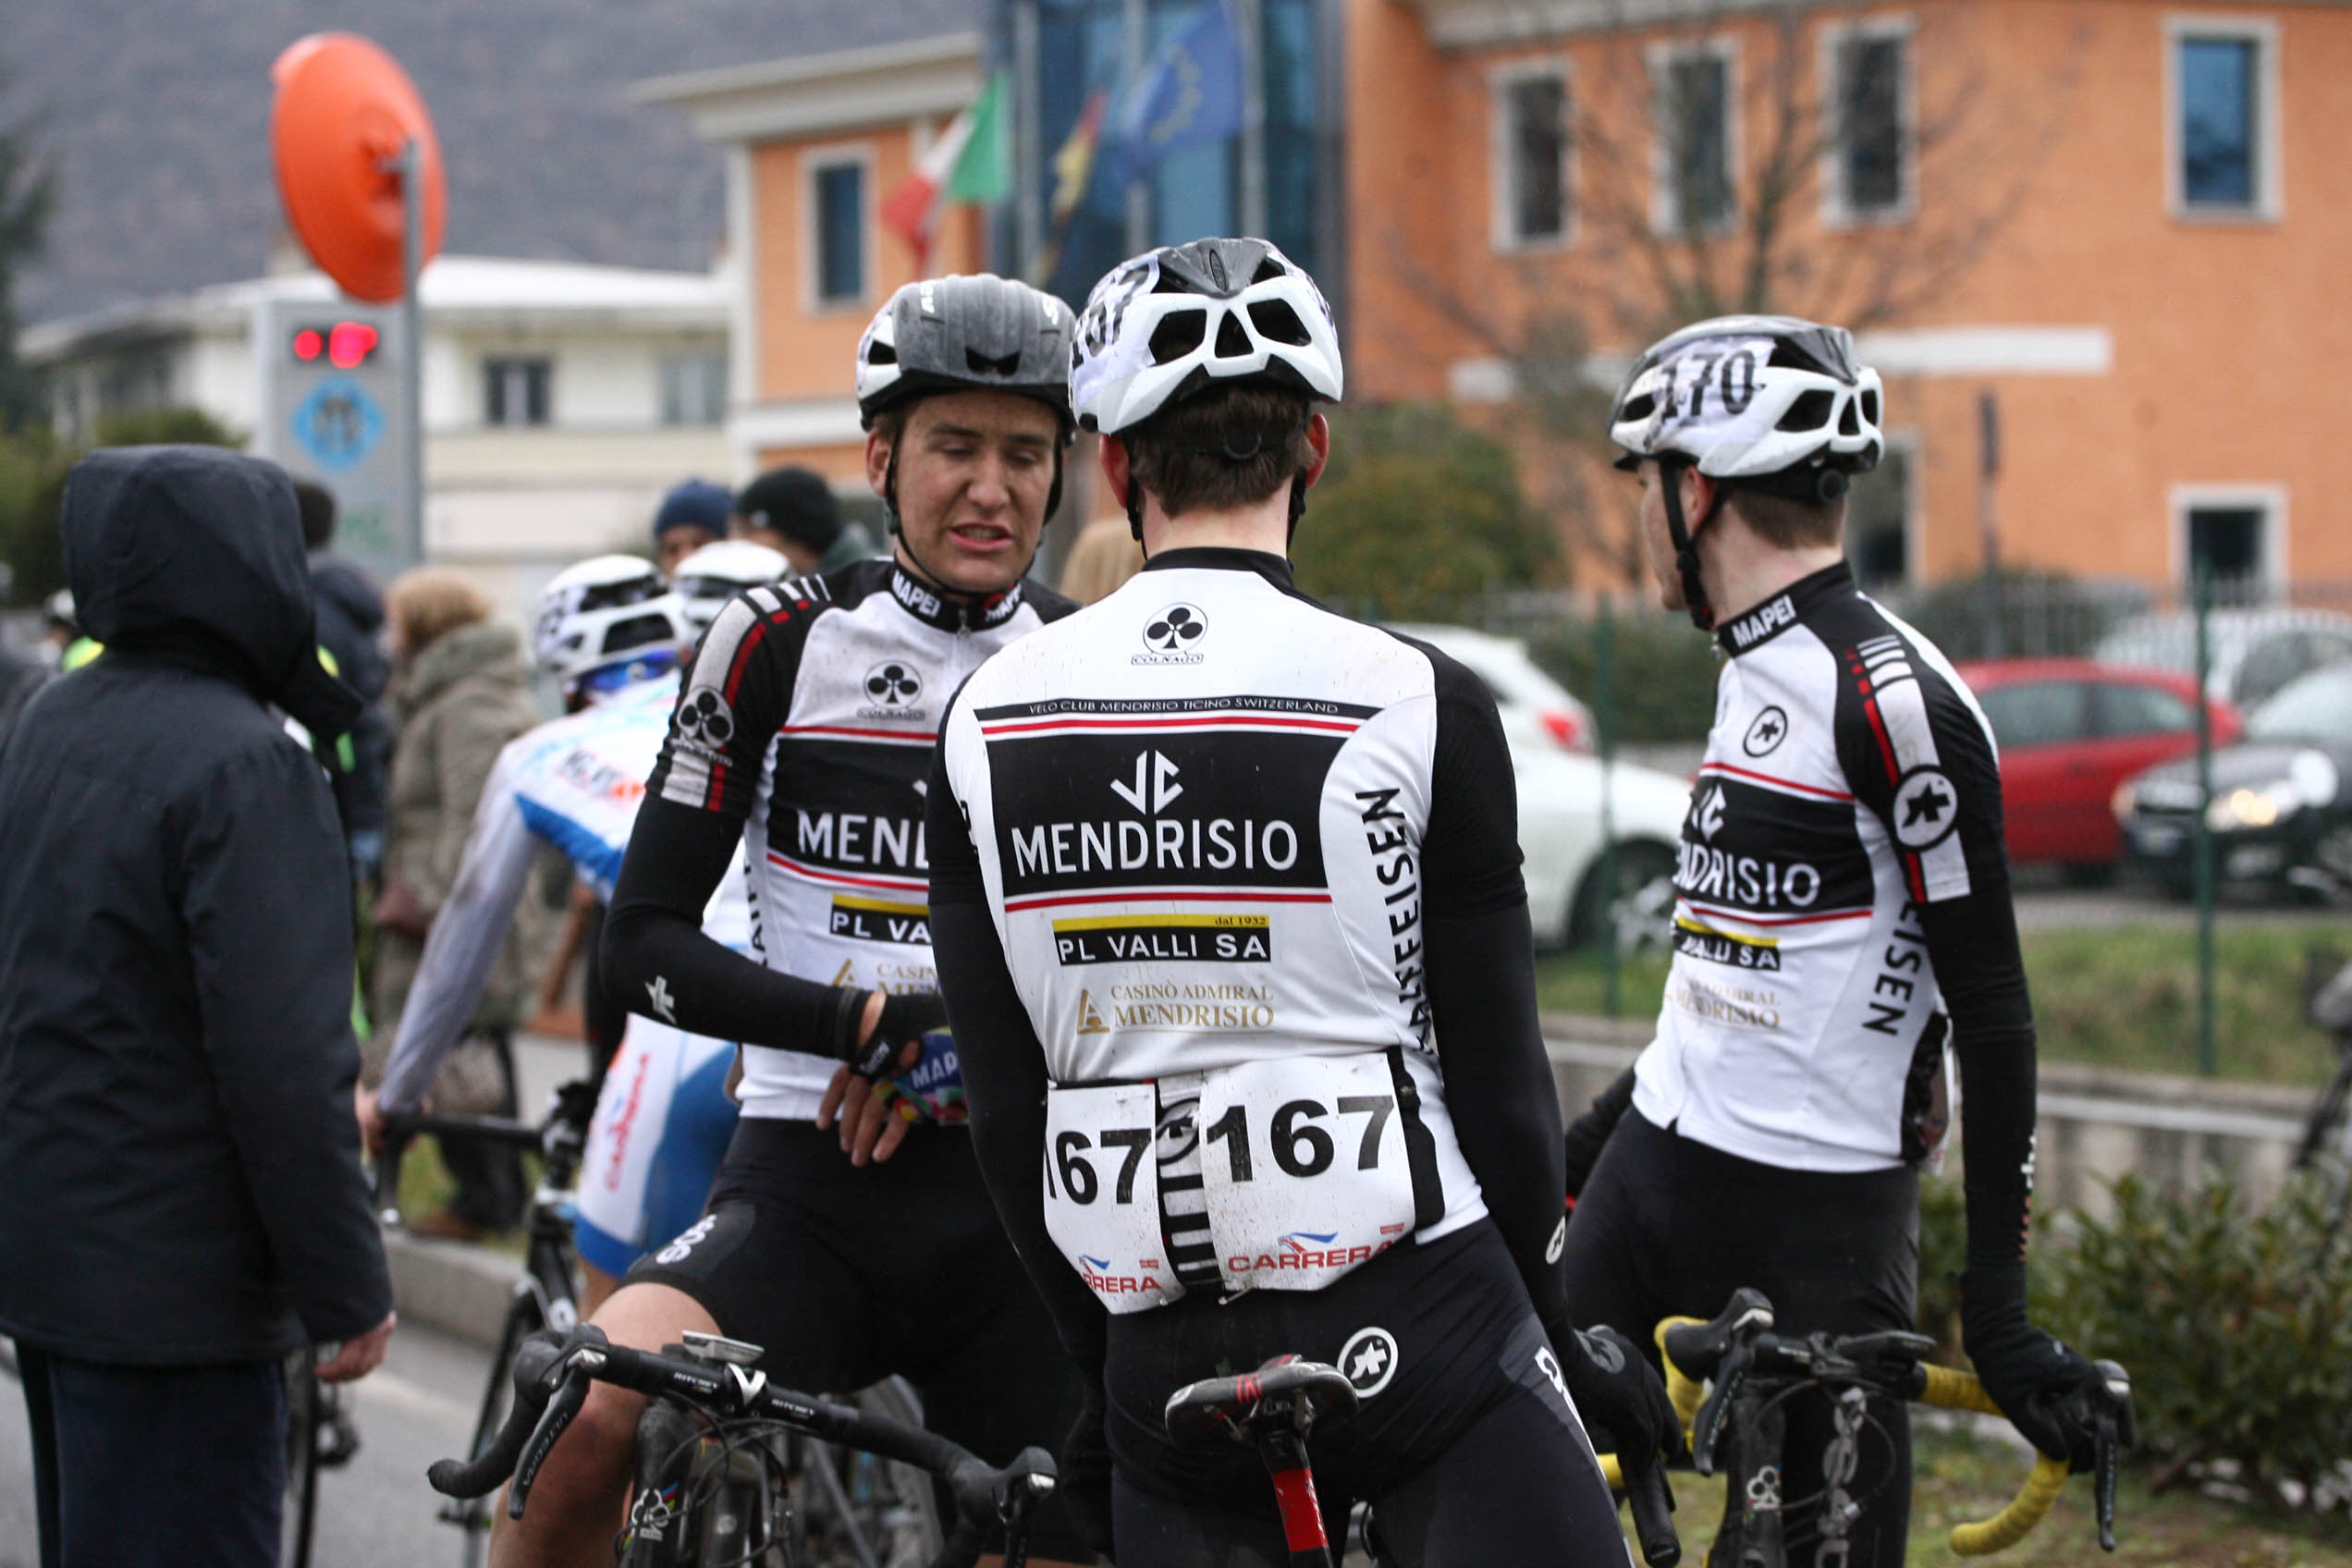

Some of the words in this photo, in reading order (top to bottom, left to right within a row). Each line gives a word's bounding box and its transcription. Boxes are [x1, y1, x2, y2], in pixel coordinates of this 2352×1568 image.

[1660, 349, 1756, 424] 170
[892, 570, 941, 618] MAPEI
[1731, 594, 1797, 648] MAPEI
[1029, 701, 1058, 715] VELO
[1060, 699, 1096, 712] CLUB
[1100, 701, 1179, 713] MENDRISIO
[1183, 699, 1231, 710] TICINO
[1235, 697, 1339, 714] SWITZERLAND
[1011, 818, 1298, 877] MENDRISIO
[833, 912, 872, 937] PL
[1215, 915, 1233, 925] dal
[1059, 938, 1096, 962] PL
[1108, 934, 1197, 958] VALLI
[1216, 934, 1267, 958] SA
[1739, 945, 1778, 969] SA
[1182, 984, 1274, 1000] ADMIRAL
[1113, 1004, 1275, 1028] MENDRISIO
[1207, 1095, 1395, 1183] 167
